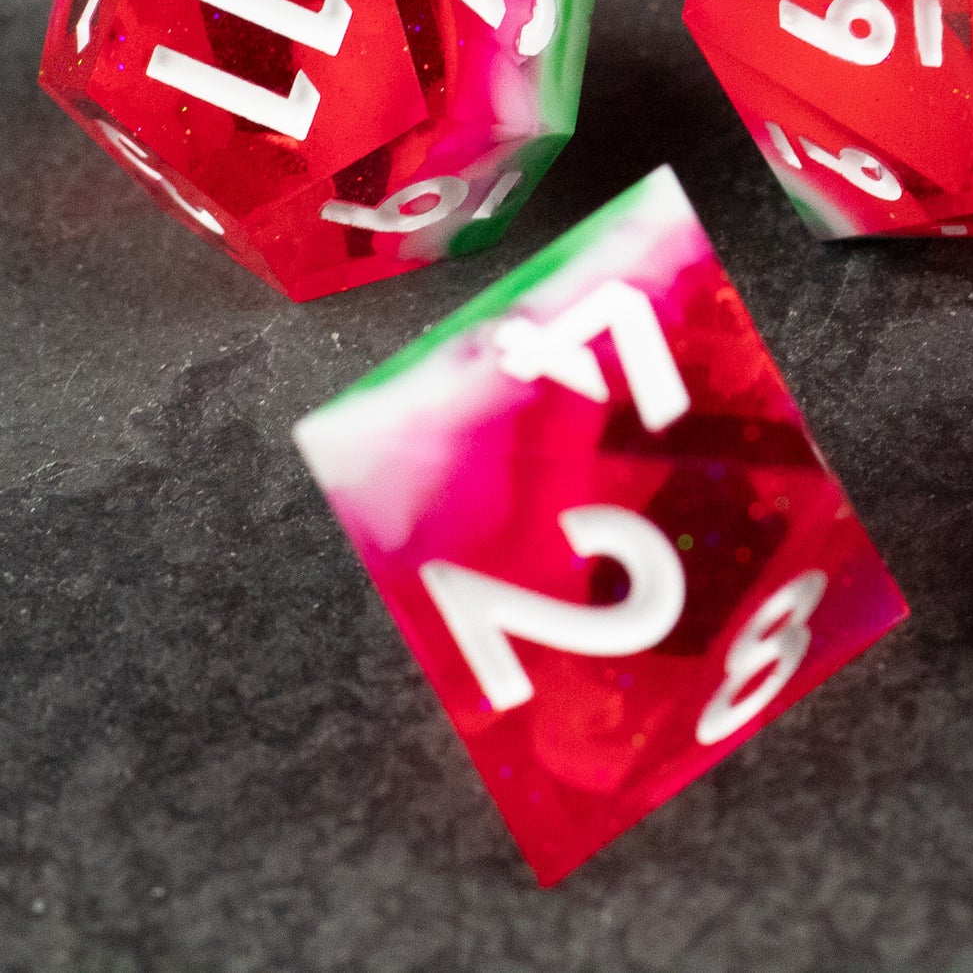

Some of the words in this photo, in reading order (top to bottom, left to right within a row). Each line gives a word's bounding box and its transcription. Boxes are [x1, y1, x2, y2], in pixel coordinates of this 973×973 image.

[493, 279, 691, 432] 4
[418, 503, 686, 713] 2
[695, 569, 828, 746] 8
